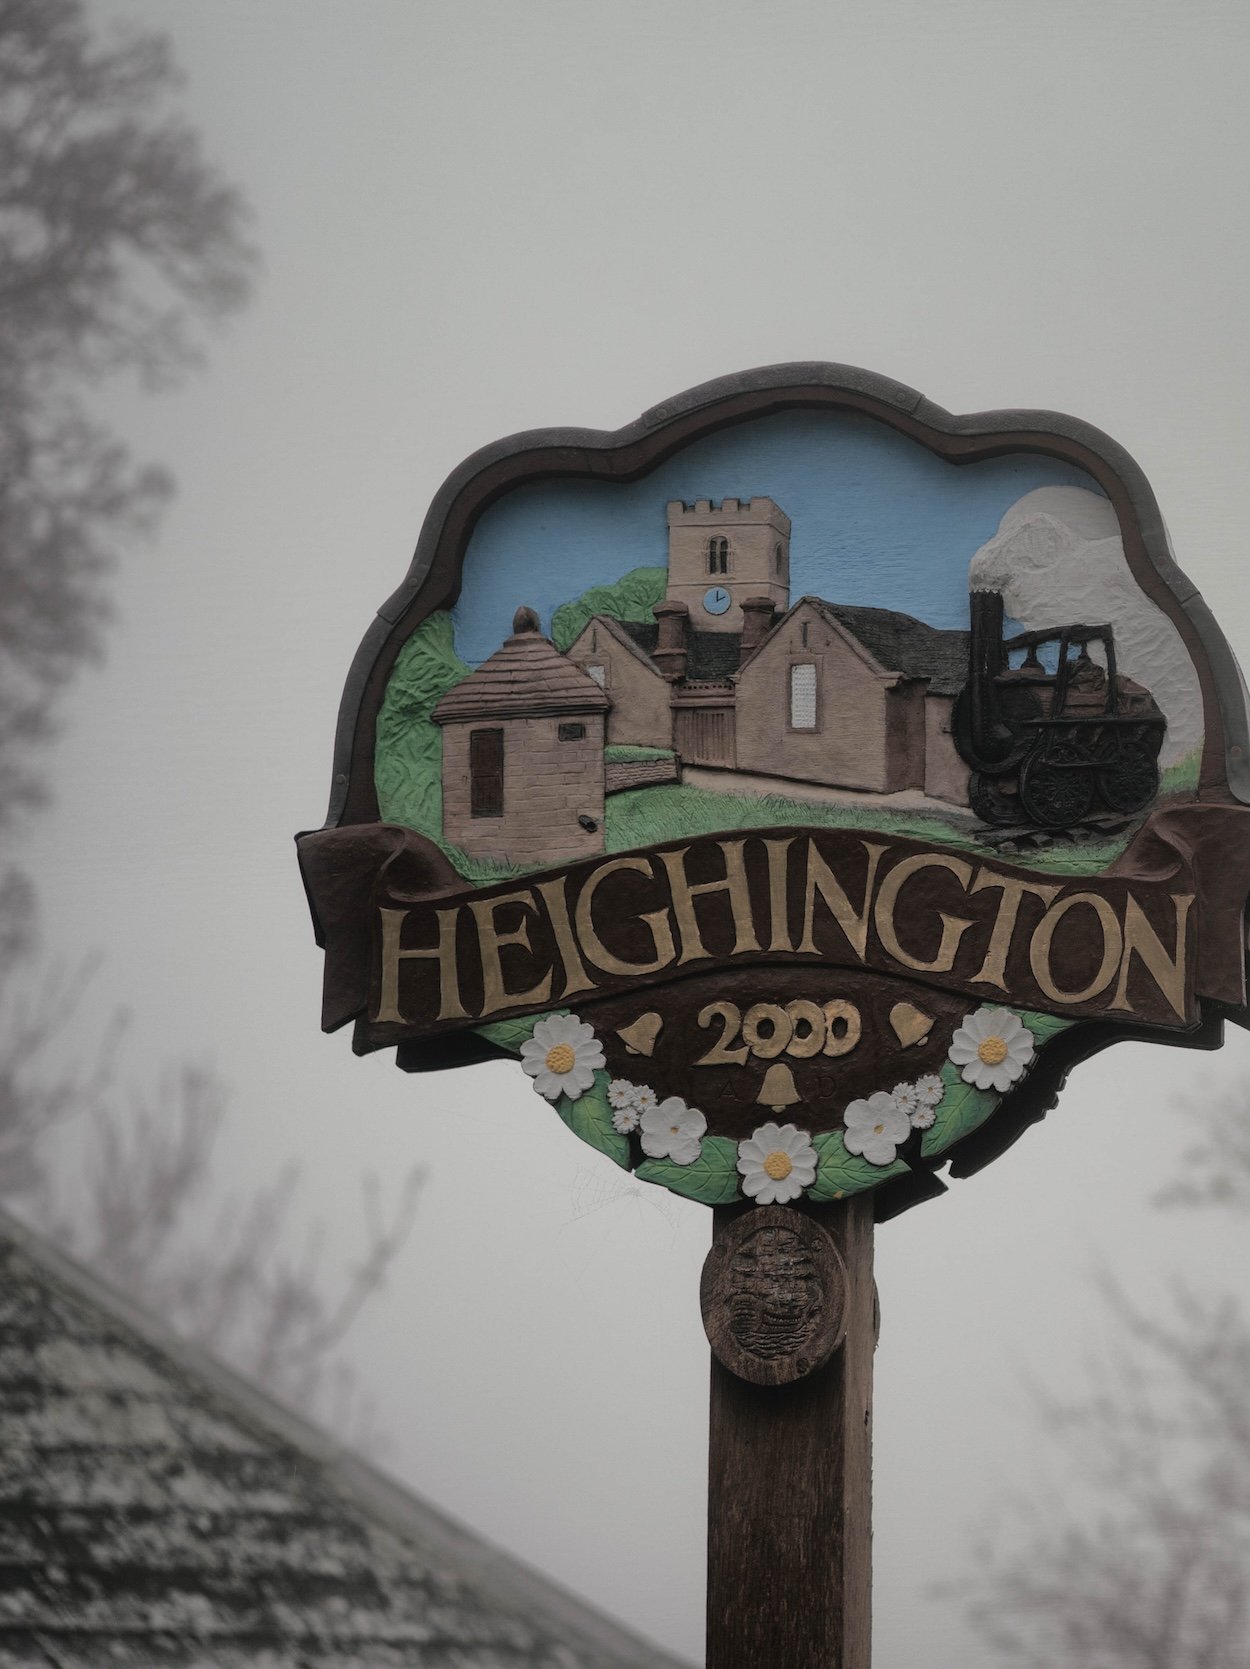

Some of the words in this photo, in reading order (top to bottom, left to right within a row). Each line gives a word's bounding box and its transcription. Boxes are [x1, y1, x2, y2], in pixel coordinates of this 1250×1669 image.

[376, 838, 1194, 1024] HEIGHINGTON
[694, 999, 862, 1066] 2000
[719, 1079, 738, 1098] A
[817, 1075, 837, 1098] D
